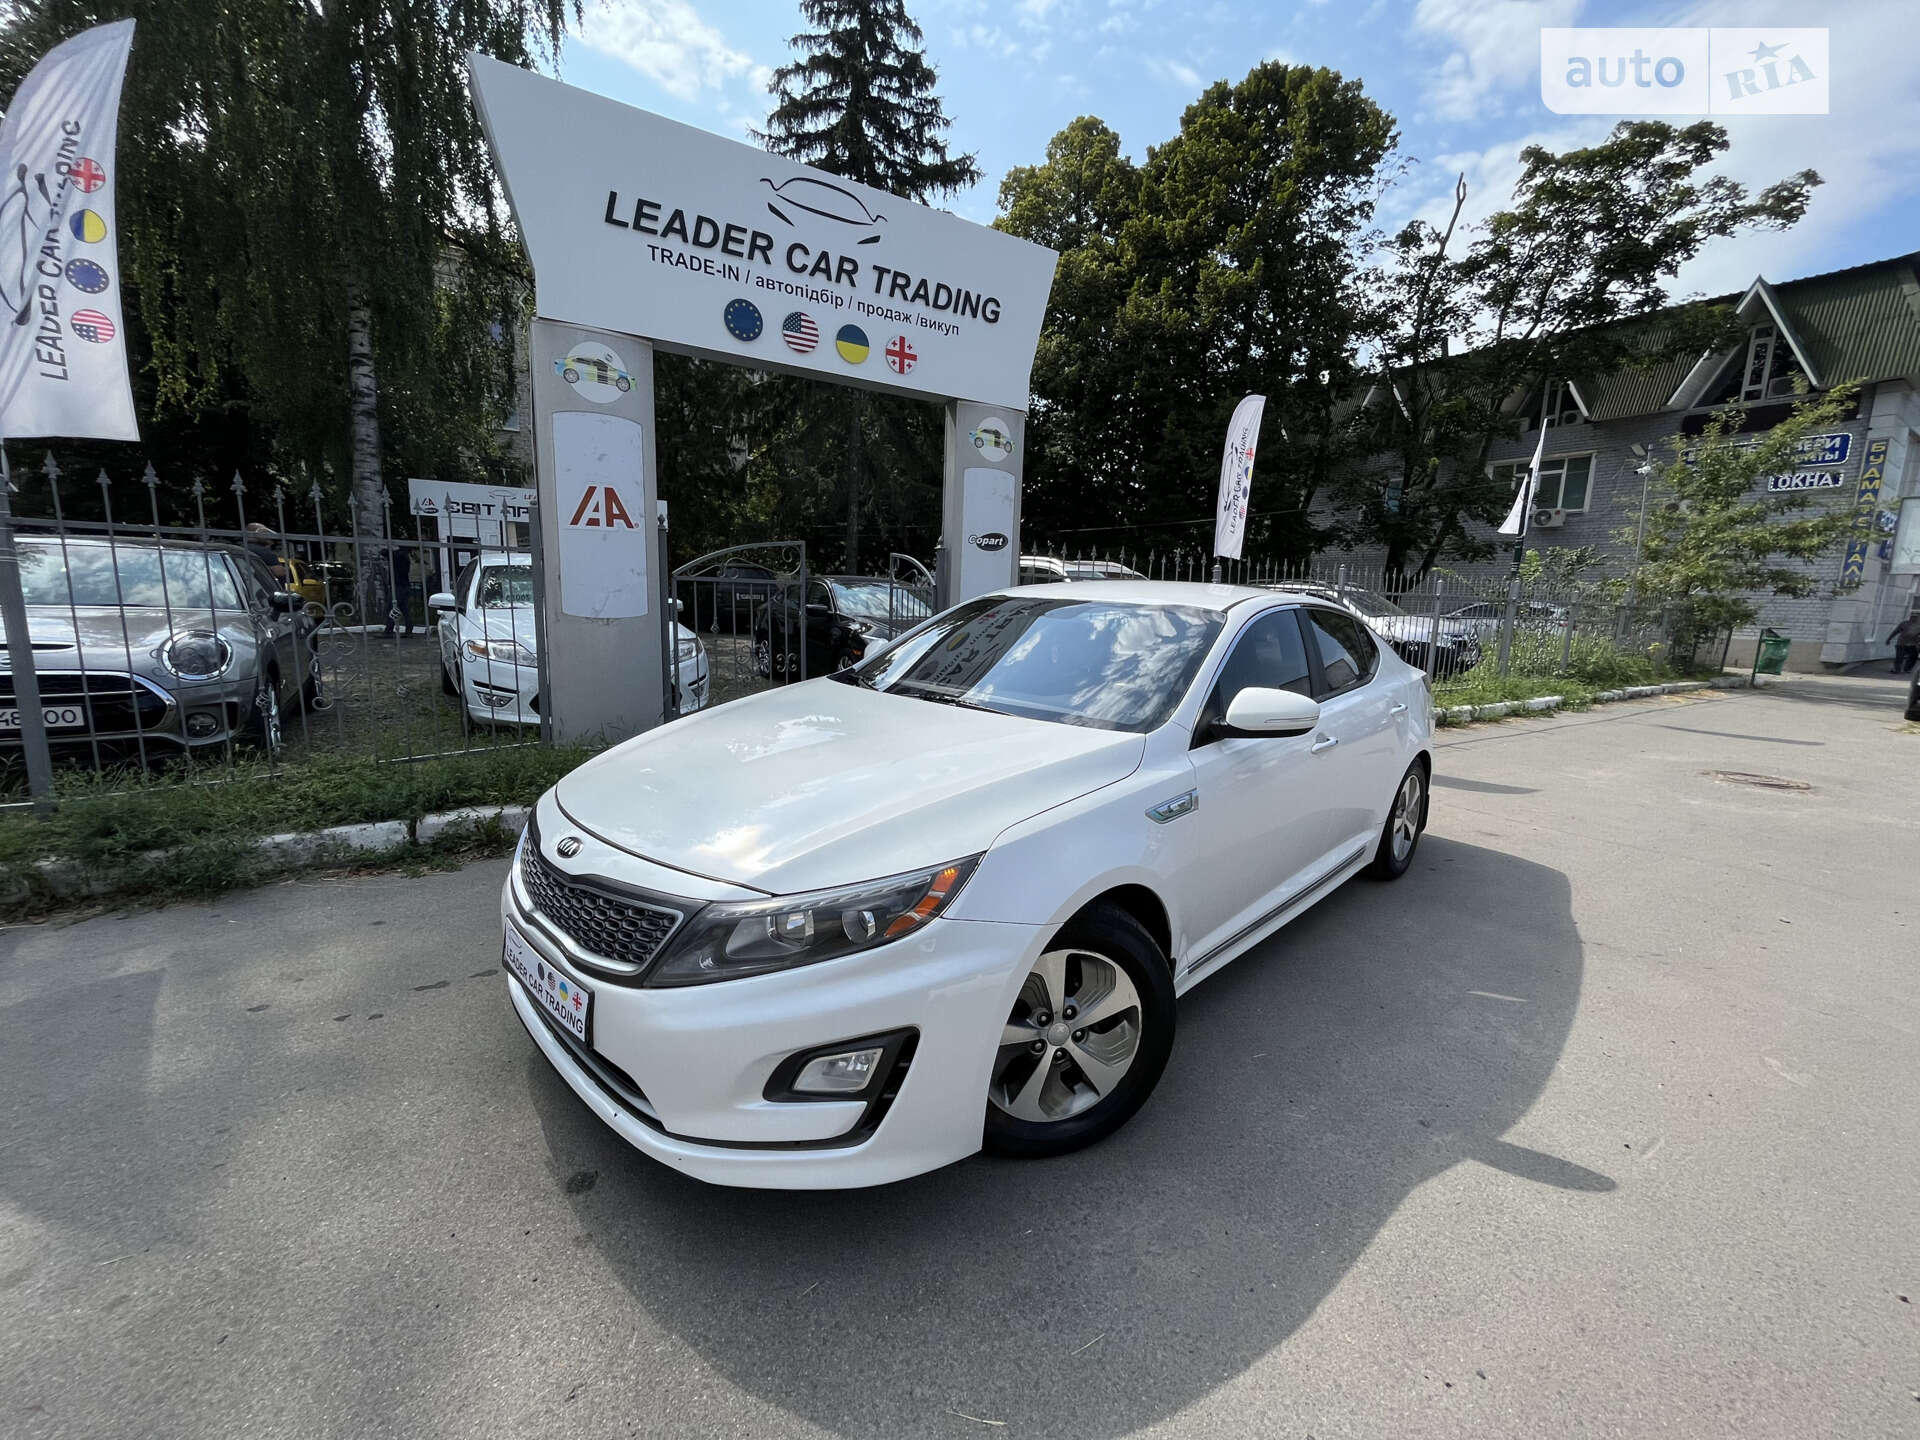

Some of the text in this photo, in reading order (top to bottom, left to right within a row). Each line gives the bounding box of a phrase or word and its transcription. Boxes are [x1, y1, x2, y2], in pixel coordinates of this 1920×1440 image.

[604, 190, 1001, 325] LEADER CAR TRADING
[646, 243, 741, 284] TRADE-IN
[755, 275, 845, 309] автопідбір
[856, 301, 913, 324] продаж
[34, 284, 69, 381] LEADER
[1777, 472, 1833, 489] ОКНА
[968, 534, 1004, 547] Copart
[506, 944, 584, 1034] LEADER CAR TRADING
